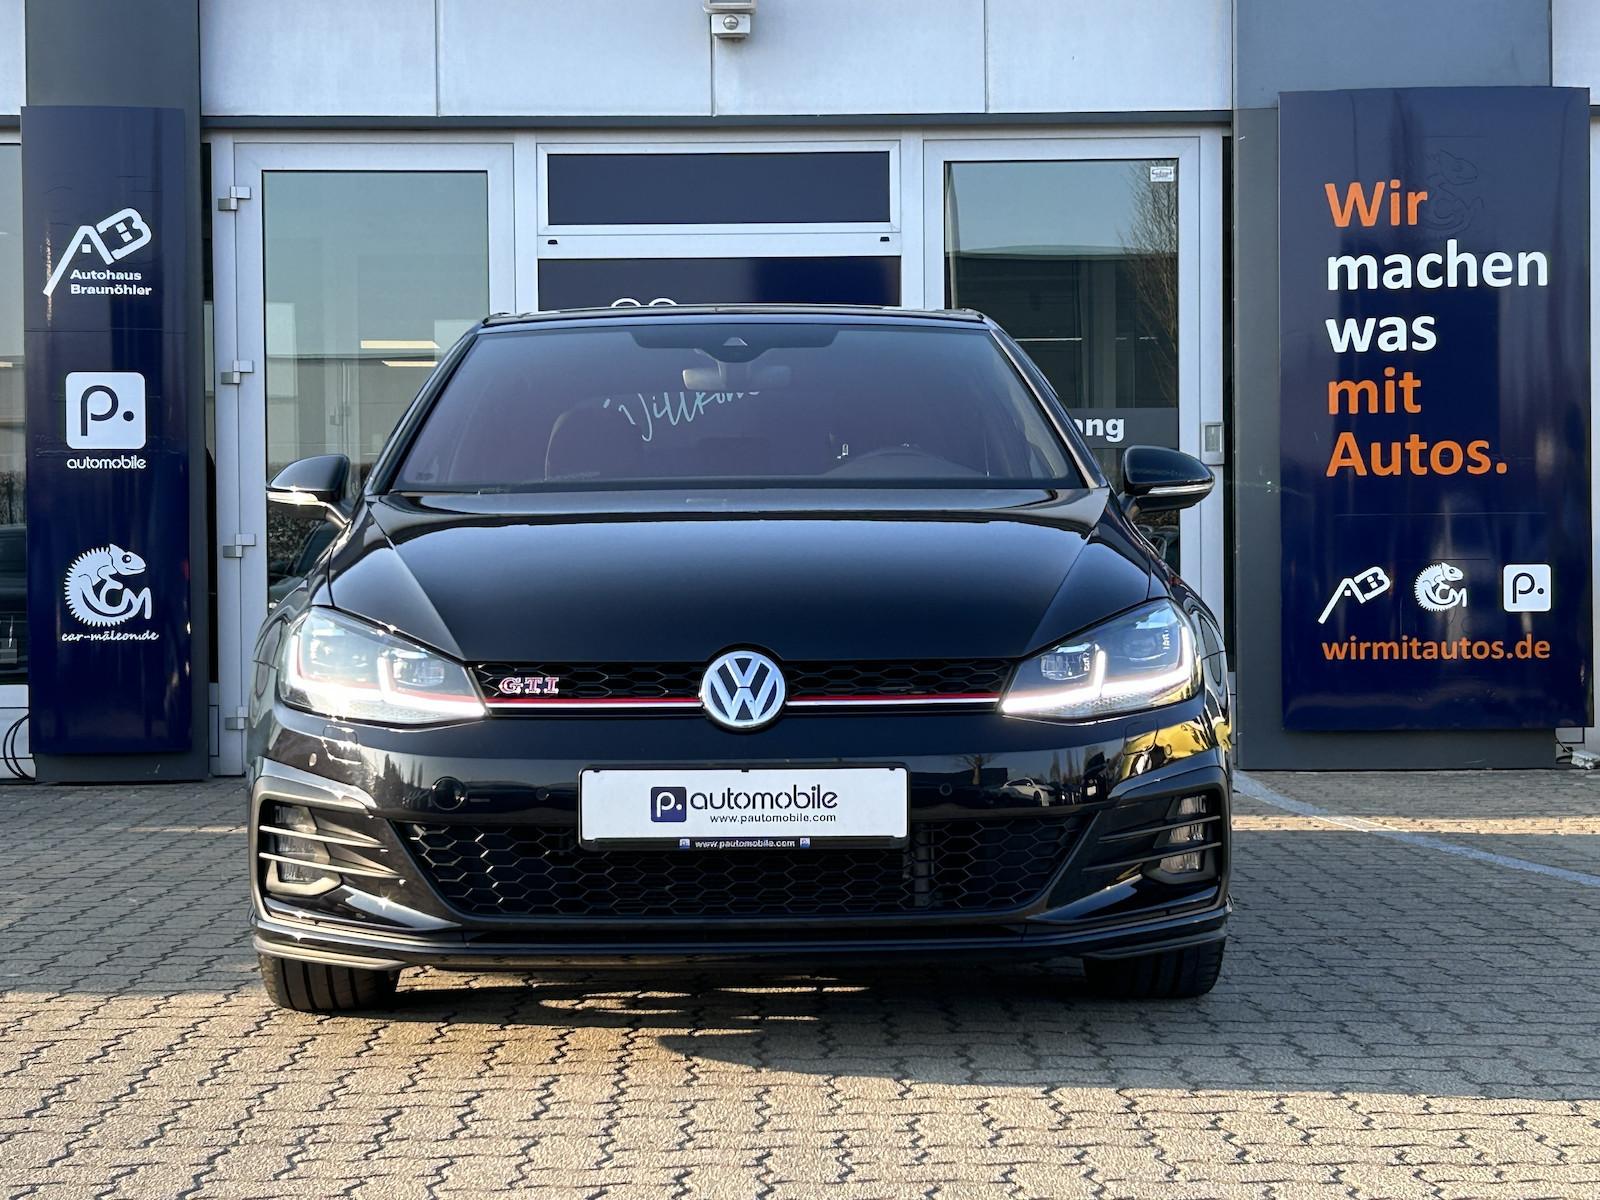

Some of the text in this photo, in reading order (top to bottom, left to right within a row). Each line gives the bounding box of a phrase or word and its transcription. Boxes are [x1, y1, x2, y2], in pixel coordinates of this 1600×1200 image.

[1325, 178, 1428, 227] Wir
[70, 269, 142, 281] Autohaus
[1327, 239, 1549, 290] machen
[70, 284, 152, 295] Braunöhler
[1325, 315, 1437, 353] was
[1328, 366, 1422, 415] mit
[66, 455, 147, 469] automobile
[1326, 431, 1508, 477] Autos.
[1321, 633, 1551, 660] wirmitautos.de
[499, 677, 560, 694] GTI
[690, 784, 838, 810] automobile
[709, 813, 837, 825] www.pautomobile.com
[695, 839, 796, 849] www.pautomobile.com
